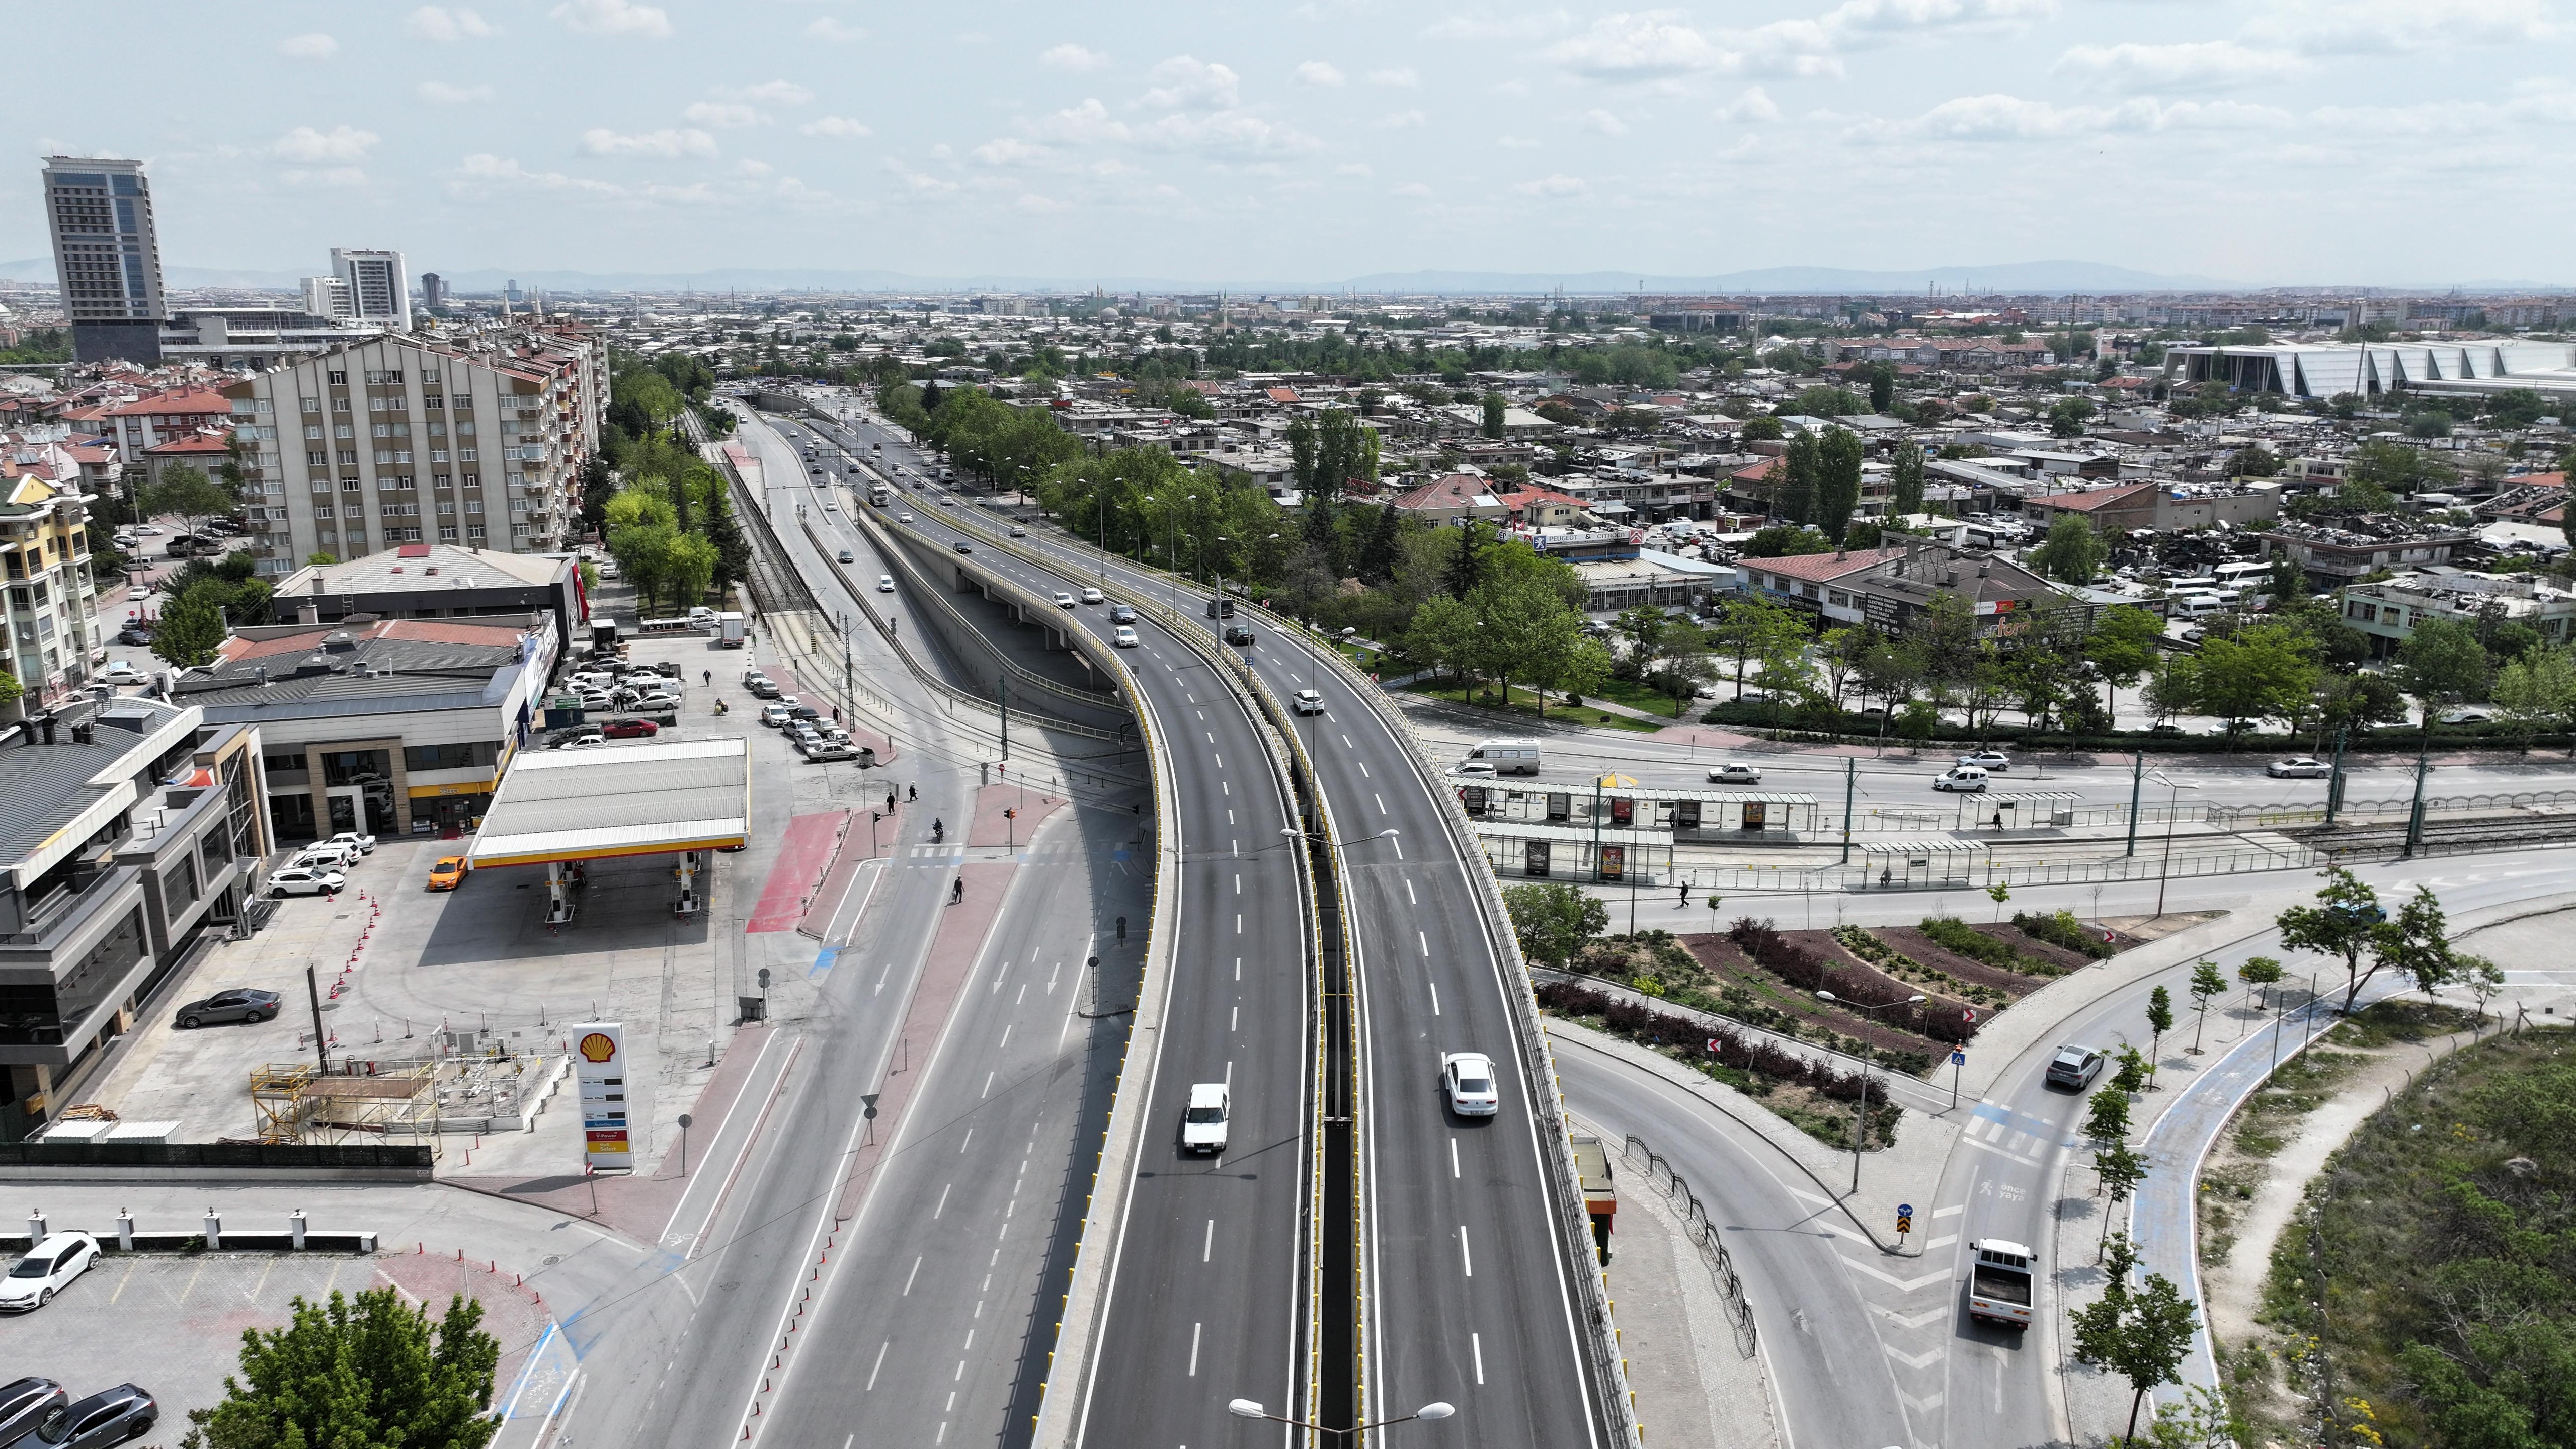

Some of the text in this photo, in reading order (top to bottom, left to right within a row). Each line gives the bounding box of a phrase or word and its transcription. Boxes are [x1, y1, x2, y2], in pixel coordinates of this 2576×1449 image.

[2385, 436, 2430, 444] AKSESUAR
[2001, 1182, 2026, 1195] önce
[1999, 1190, 2024, 1201] yaya
